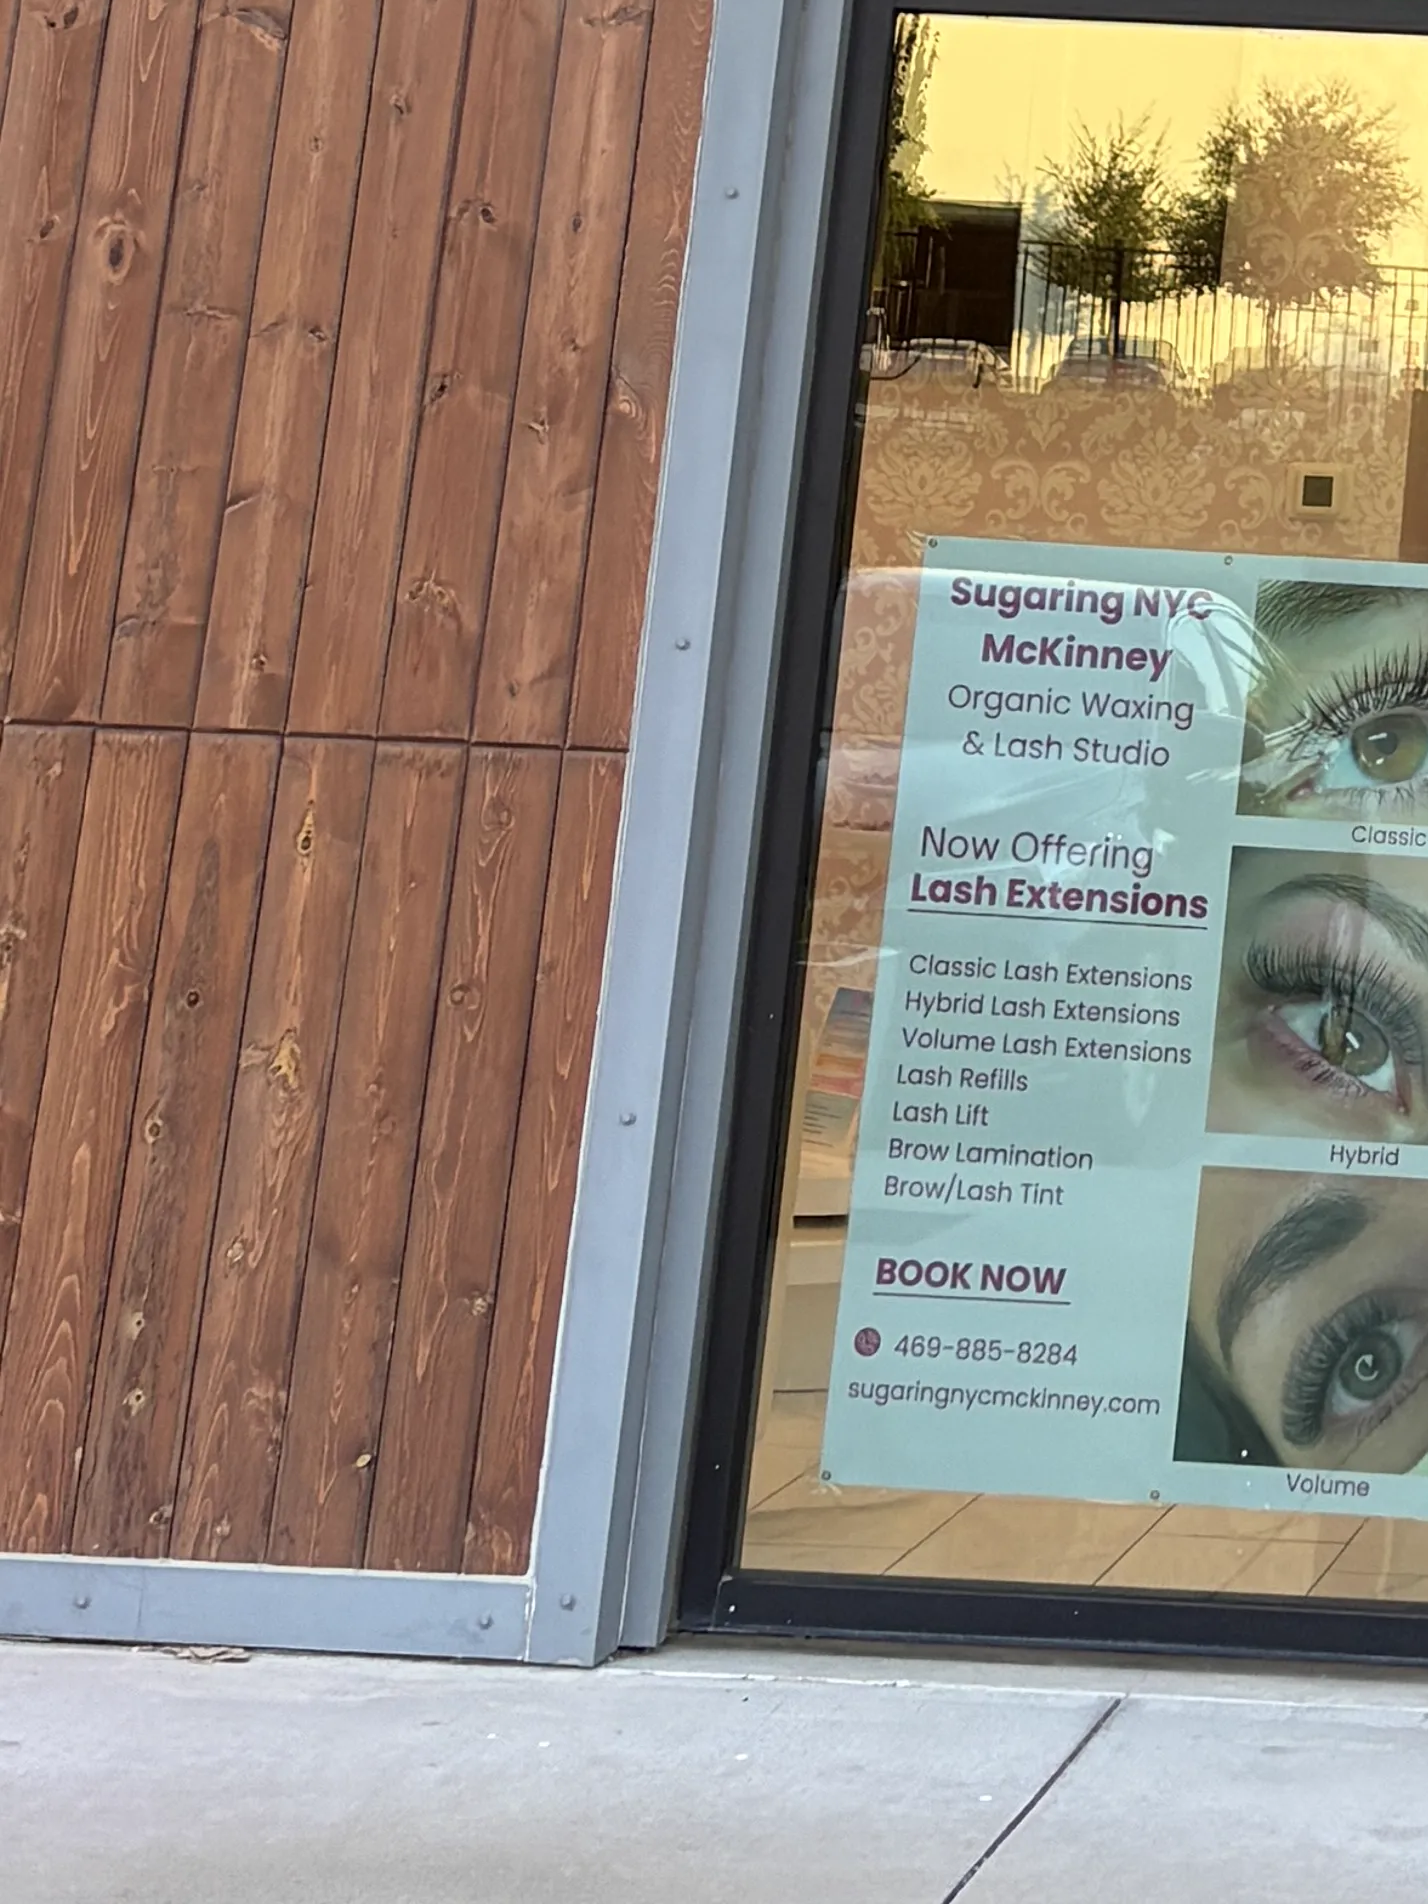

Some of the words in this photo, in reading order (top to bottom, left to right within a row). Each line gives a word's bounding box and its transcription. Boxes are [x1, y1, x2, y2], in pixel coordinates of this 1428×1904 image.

[950, 577, 1125, 624] Sugaring
[1132, 586, 1215, 620] NYC
[980, 632, 1173, 682] McKinney
[946, 683, 1072, 719] Organic
[1081, 692, 1195, 730] Waxing
[961, 733, 987, 759] &
[993, 731, 1064, 763] Lash
[1071, 737, 1171, 768] Studio
[920, 825, 1001, 861] Now
[1010, 830, 1154, 878] Offering
[1350, 824, 1428, 849] Classic
[909, 873, 997, 907] Lash
[1005, 876, 1209, 922] Extensions
[909, 954, 997, 981] Classic
[1003, 958, 1059, 984] Lash
[1066, 962, 1194, 992] Extensions
[904, 991, 985, 1022] Hybrid
[990, 995, 1045, 1019] Lash
[1053, 998, 1181, 1027] Extensions
[901, 1028, 996, 1054] Volume
[1002, 1031, 1058, 1056] Lash
[1065, 1035, 1193, 1065] Extensions
[896, 1065, 951, 1091] Lash
[956, 1066, 1029, 1093] Refills
[892, 1101, 948, 1126] Lash
[954, 1102, 989, 1128] Lift
[888, 1137, 950, 1163] Brow
[955, 1141, 1094, 1171] Lamination
[1329, 1143, 1401, 1169] Hybrid
[883, 1174, 1013, 1204] Brow/Lash
[1020, 1181, 1065, 1206] Tint
[875, 1258, 973, 1290] BOOK
[980, 1265, 1068, 1296] NOW
[893, 1334, 1079, 1368] 469-885-8284
[847, 1379, 1162, 1418] sugaringnycmckinney.com
[1285, 1472, 1371, 1499] Volume
